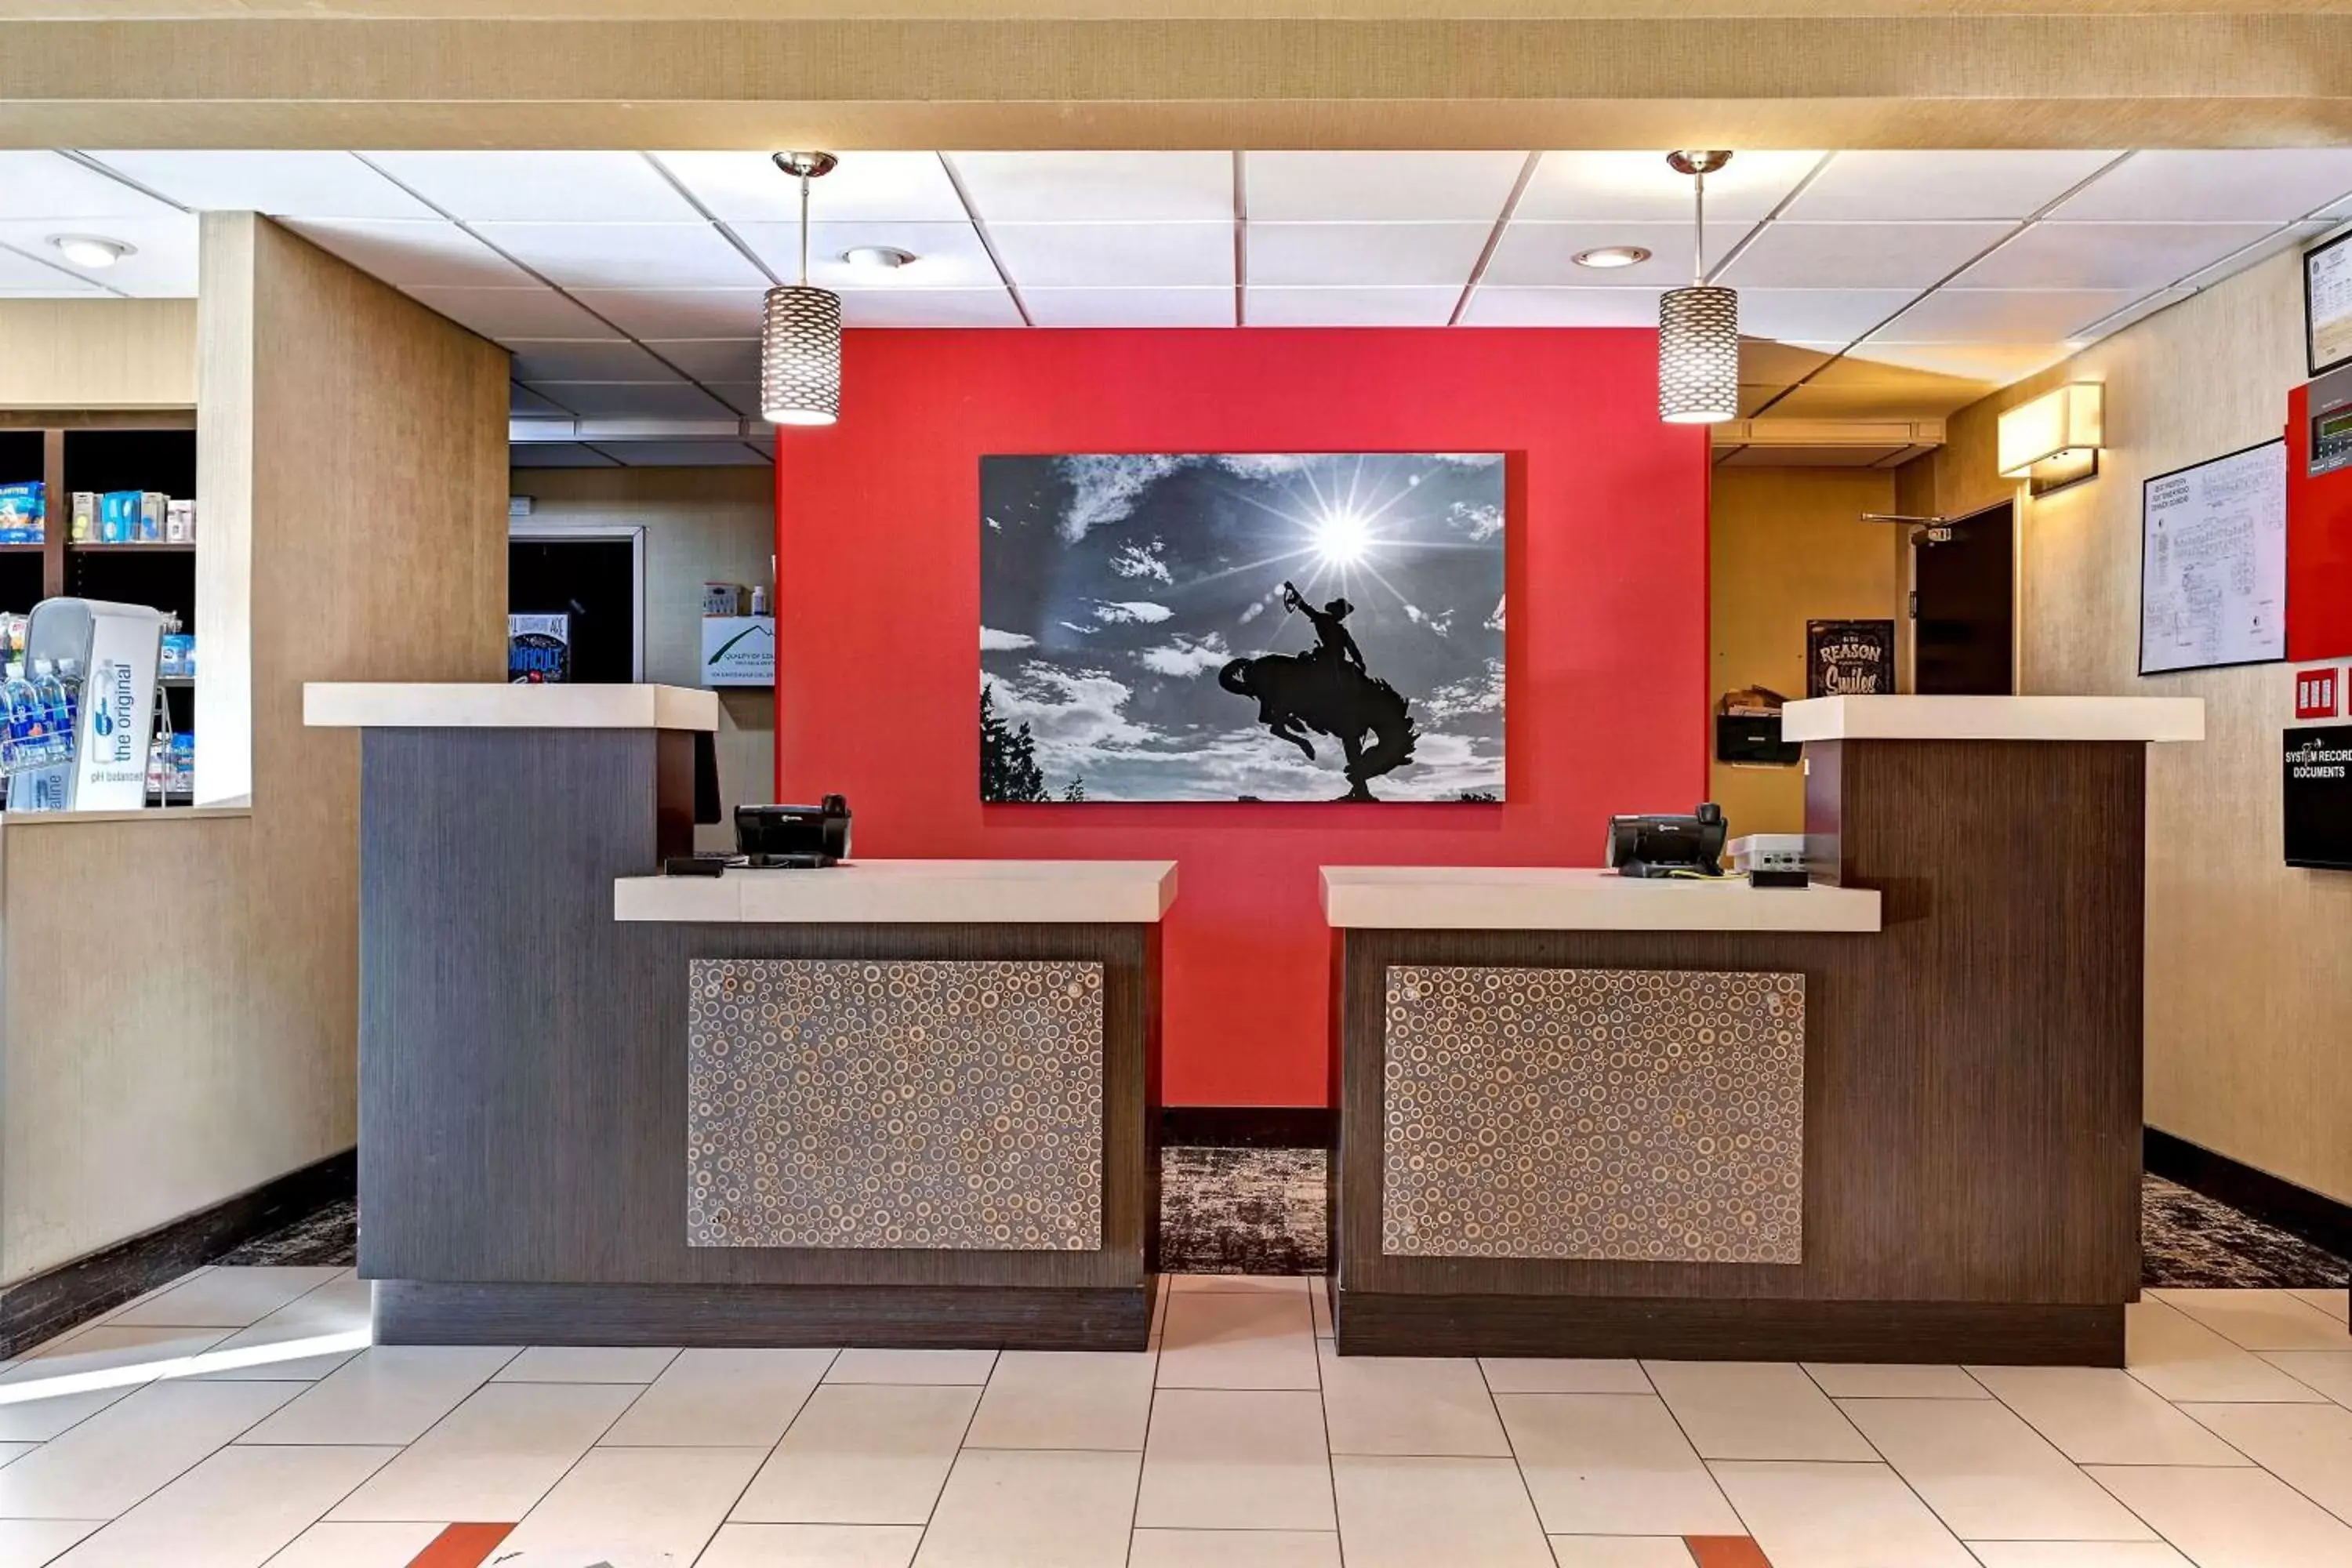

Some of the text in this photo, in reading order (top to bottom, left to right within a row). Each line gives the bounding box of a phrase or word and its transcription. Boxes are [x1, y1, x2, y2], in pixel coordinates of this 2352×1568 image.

[1820, 644, 1882, 664] REASON
[1825, 665, 1877, 696] Smiles
[114, 664, 134, 762] the original
[2293, 766, 2345, 779] DOCUMENTS
